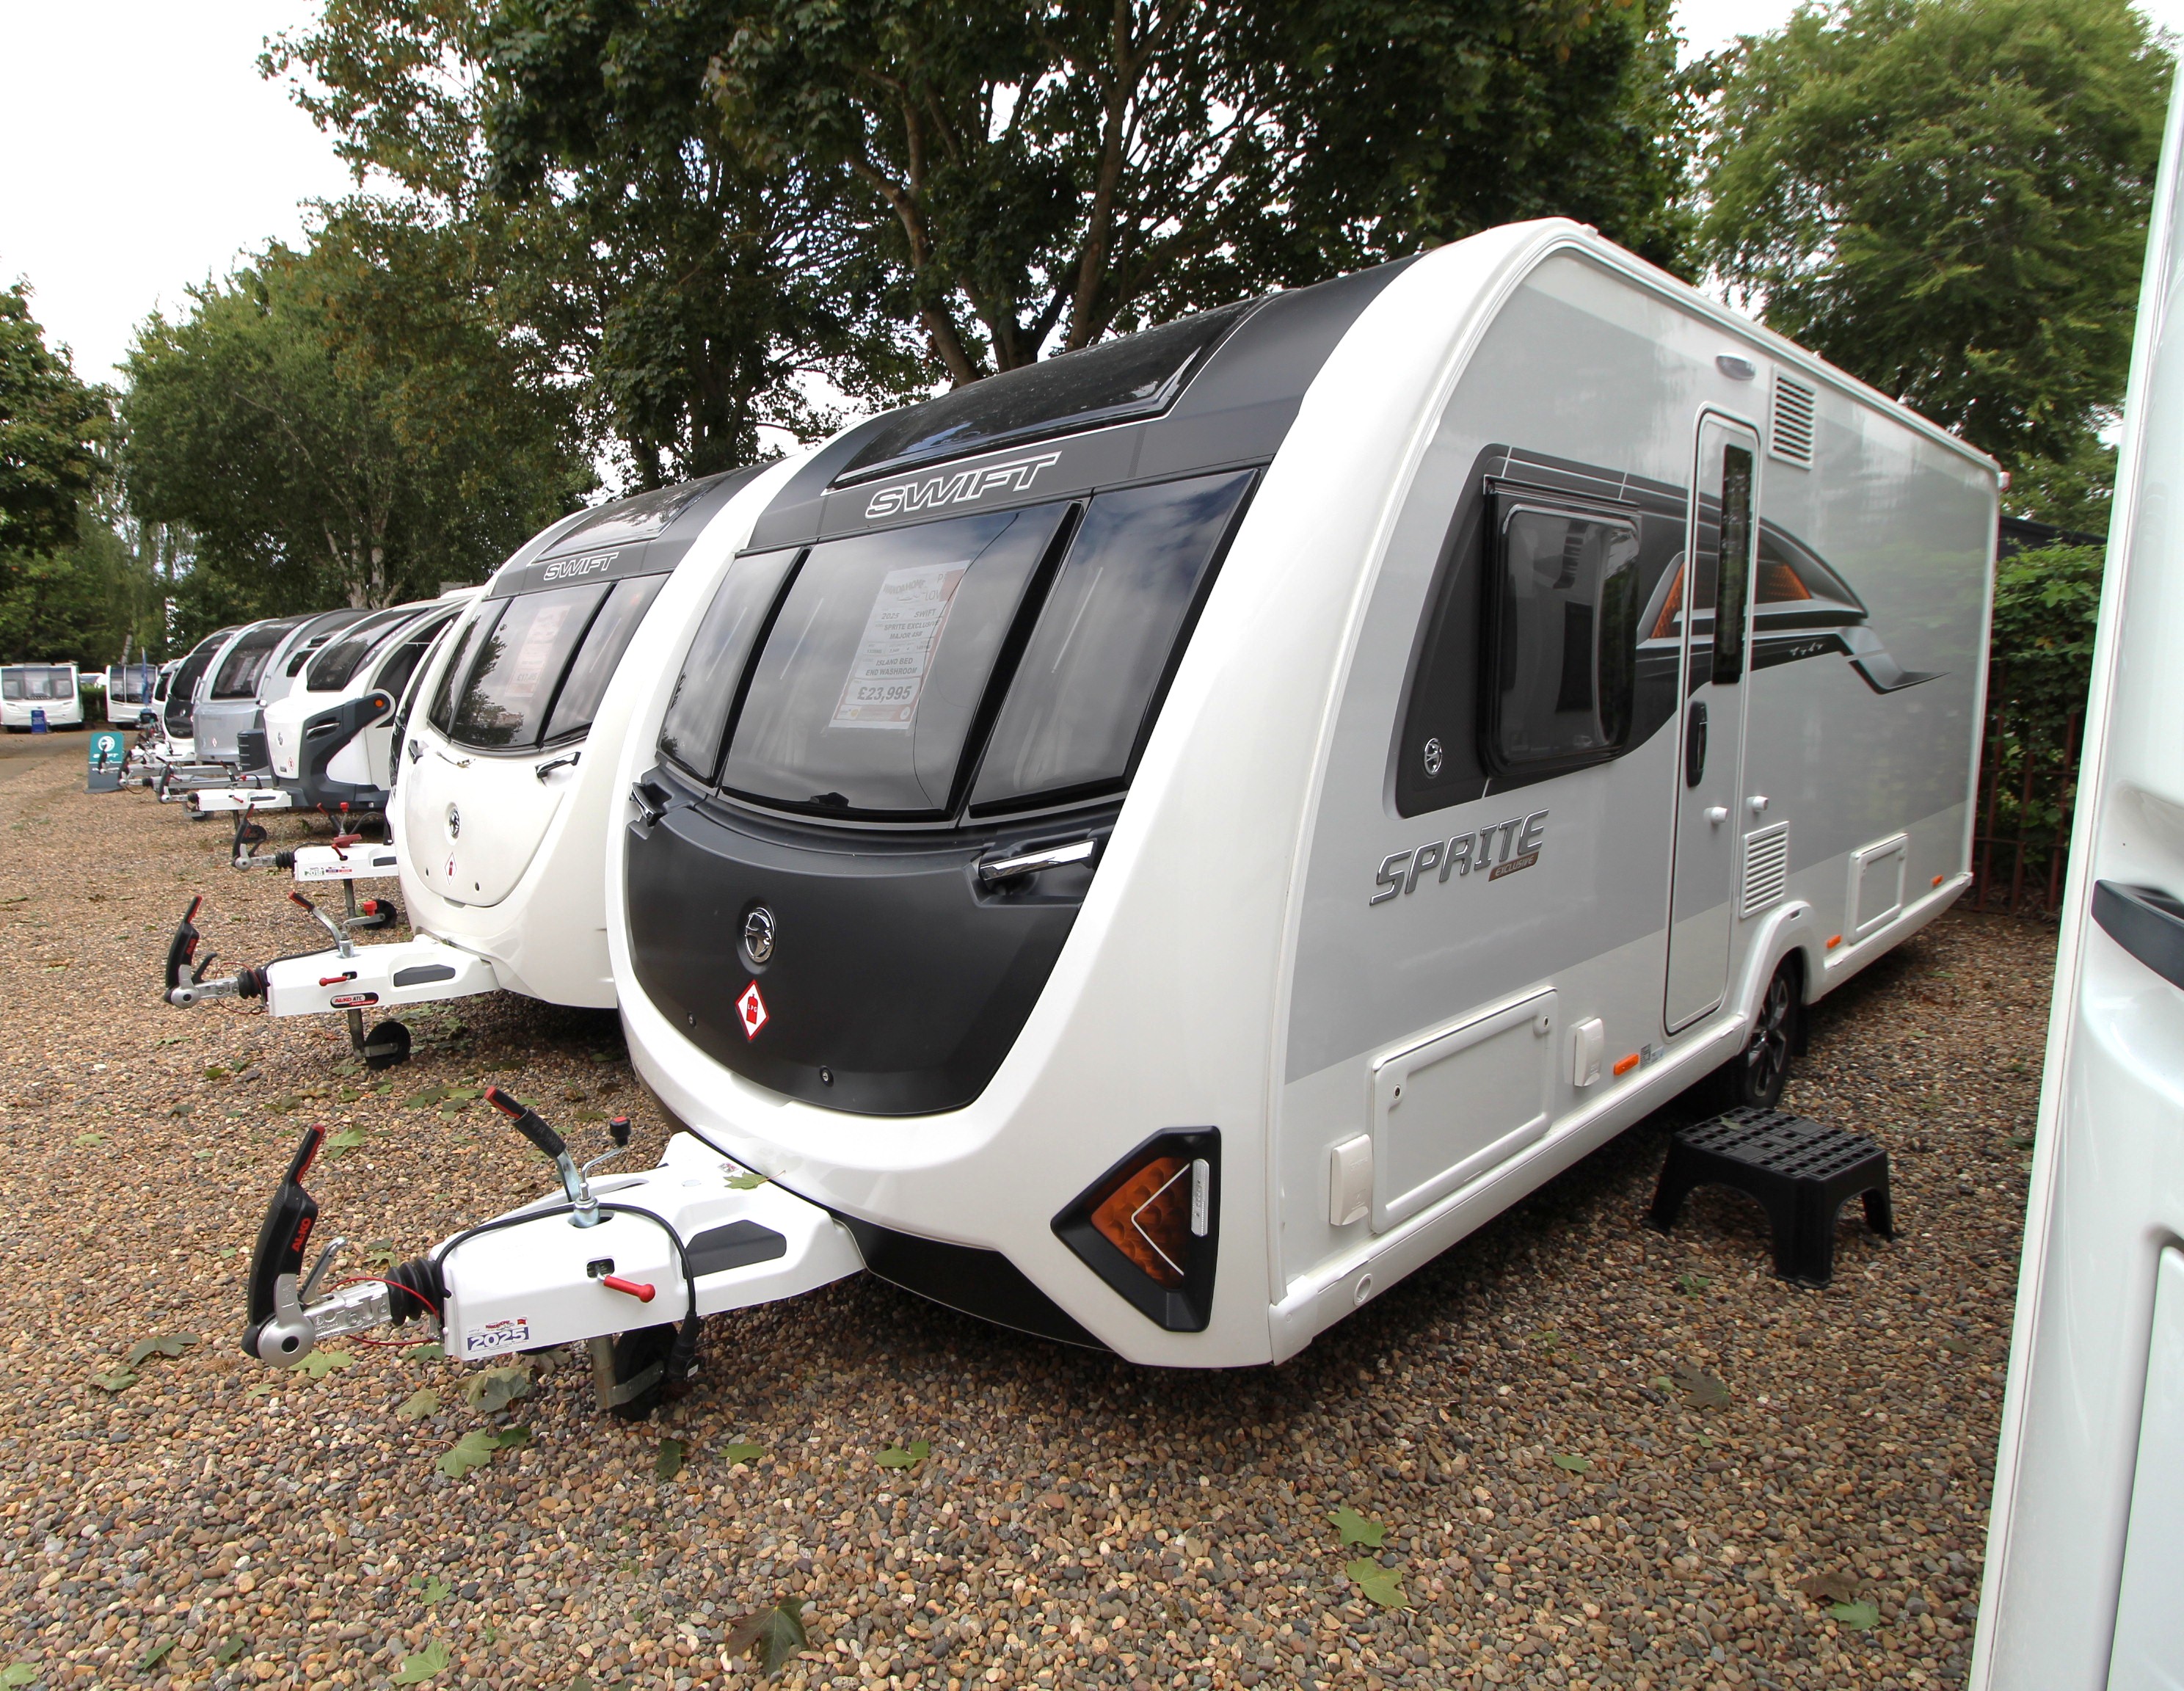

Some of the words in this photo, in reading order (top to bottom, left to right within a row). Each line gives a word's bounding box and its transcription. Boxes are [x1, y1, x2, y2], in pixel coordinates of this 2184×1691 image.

[865, 451, 1061, 519] SWIFT
[544, 552, 619, 581] SWIFT
[914, 608, 936, 618] SWIFT
[884, 622, 906, 630] SPRITE
[907, 620, 941, 630] EXCLUSIVE
[876, 658, 898, 666] ISLAND
[880, 667, 917, 675] WASHROOM
[857, 686, 912, 703] £23,995
[1369, 808, 1549, 906] SPRITE
[1495, 855, 1535, 877] EXCLUSIVE
[747, 1003, 757, 1013] LPG
[291, 1217, 312, 1252] AL-KO
[470, 1328, 526, 1350] 2025
